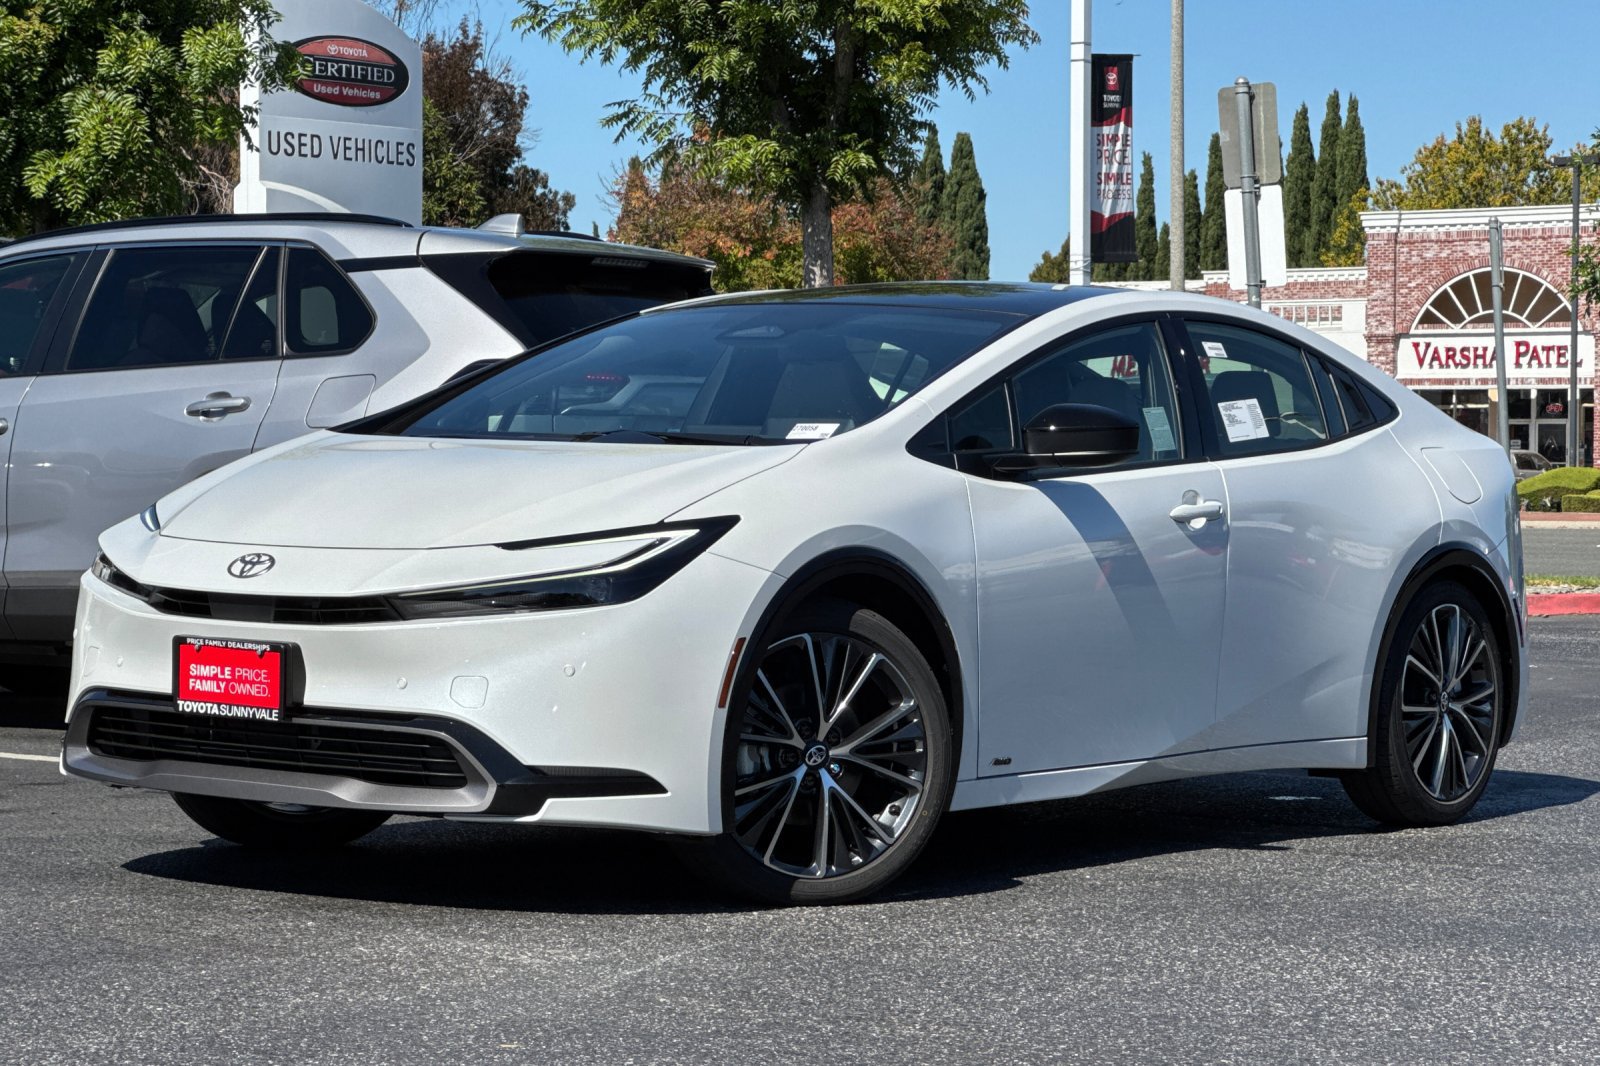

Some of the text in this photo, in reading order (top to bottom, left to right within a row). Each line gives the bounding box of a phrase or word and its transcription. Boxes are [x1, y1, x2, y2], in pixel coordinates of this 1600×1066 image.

[339, 47, 368, 57] TOYOTA
[313, 83, 381, 99] Used Vehicles
[1096, 133, 1131, 147] SIMPLE
[267, 130, 416, 167] USED VEHICLES
[1096, 172, 1132, 185] SIMPLE
[1546, 403, 1563, 414] OPEN
[205, 640, 226, 648] FAMILY
[227, 642, 270, 651] DEALERSHIPS
[189, 664, 231, 679] SIMPLE
[189, 679, 226, 693] FAMILY
[177, 700, 279, 721] TOYOTA SUNNYVALE
